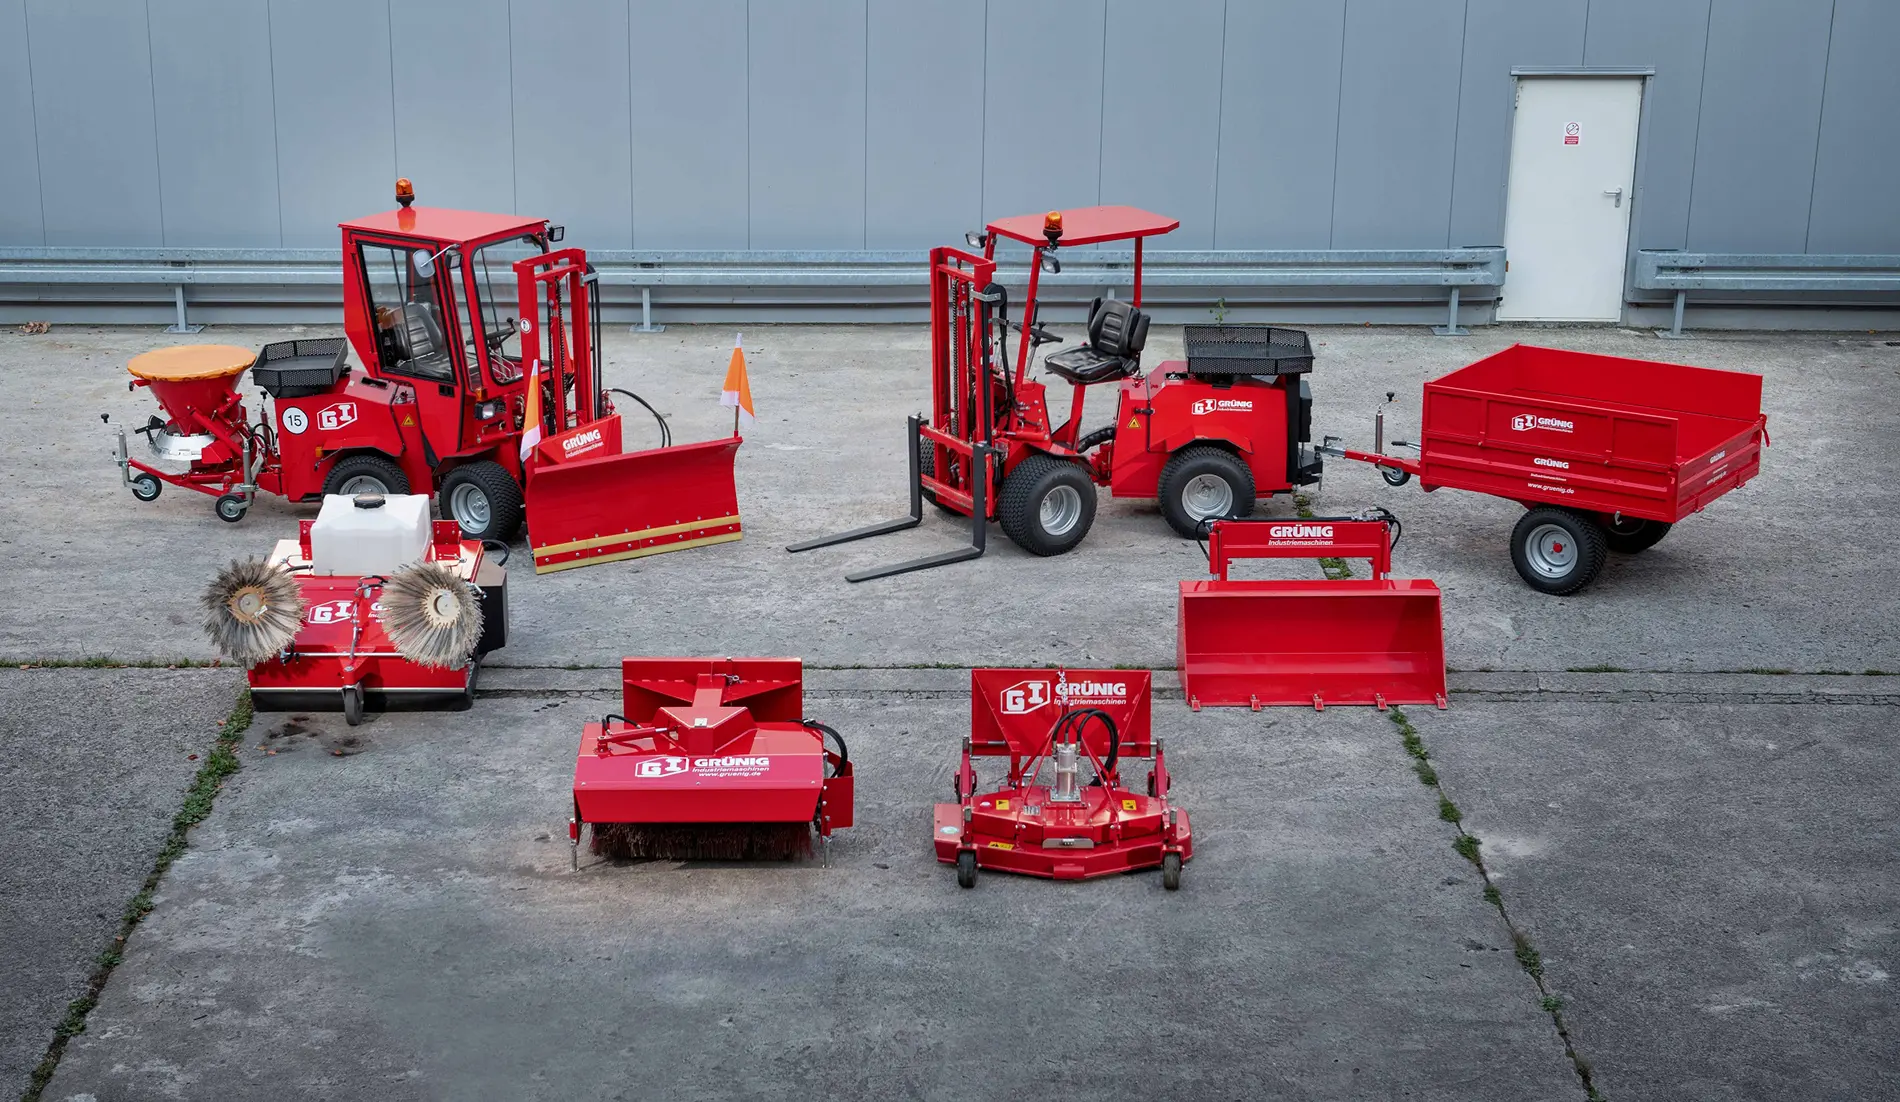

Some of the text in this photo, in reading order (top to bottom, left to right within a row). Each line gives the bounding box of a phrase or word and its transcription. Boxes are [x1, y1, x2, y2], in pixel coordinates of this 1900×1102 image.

[1195, 400, 1253, 414] GI GRÜNIG
[288, 414, 302, 427] 15
[321, 404, 352, 428] GI
[1514, 415, 1574, 430] GI GRÜNIG
[562, 429, 602, 450] GRÜNIG
[1533, 457, 1570, 470] GRÜNIG
[1527, 482, 1575, 494] www.gruenig.de
[1269, 524, 1334, 538] GRÜNIG
[314, 602, 352, 622] GI
[1006, 680, 1127, 712] GI GRÜNIG
[641, 756, 770, 776] GI GRÜNIG
